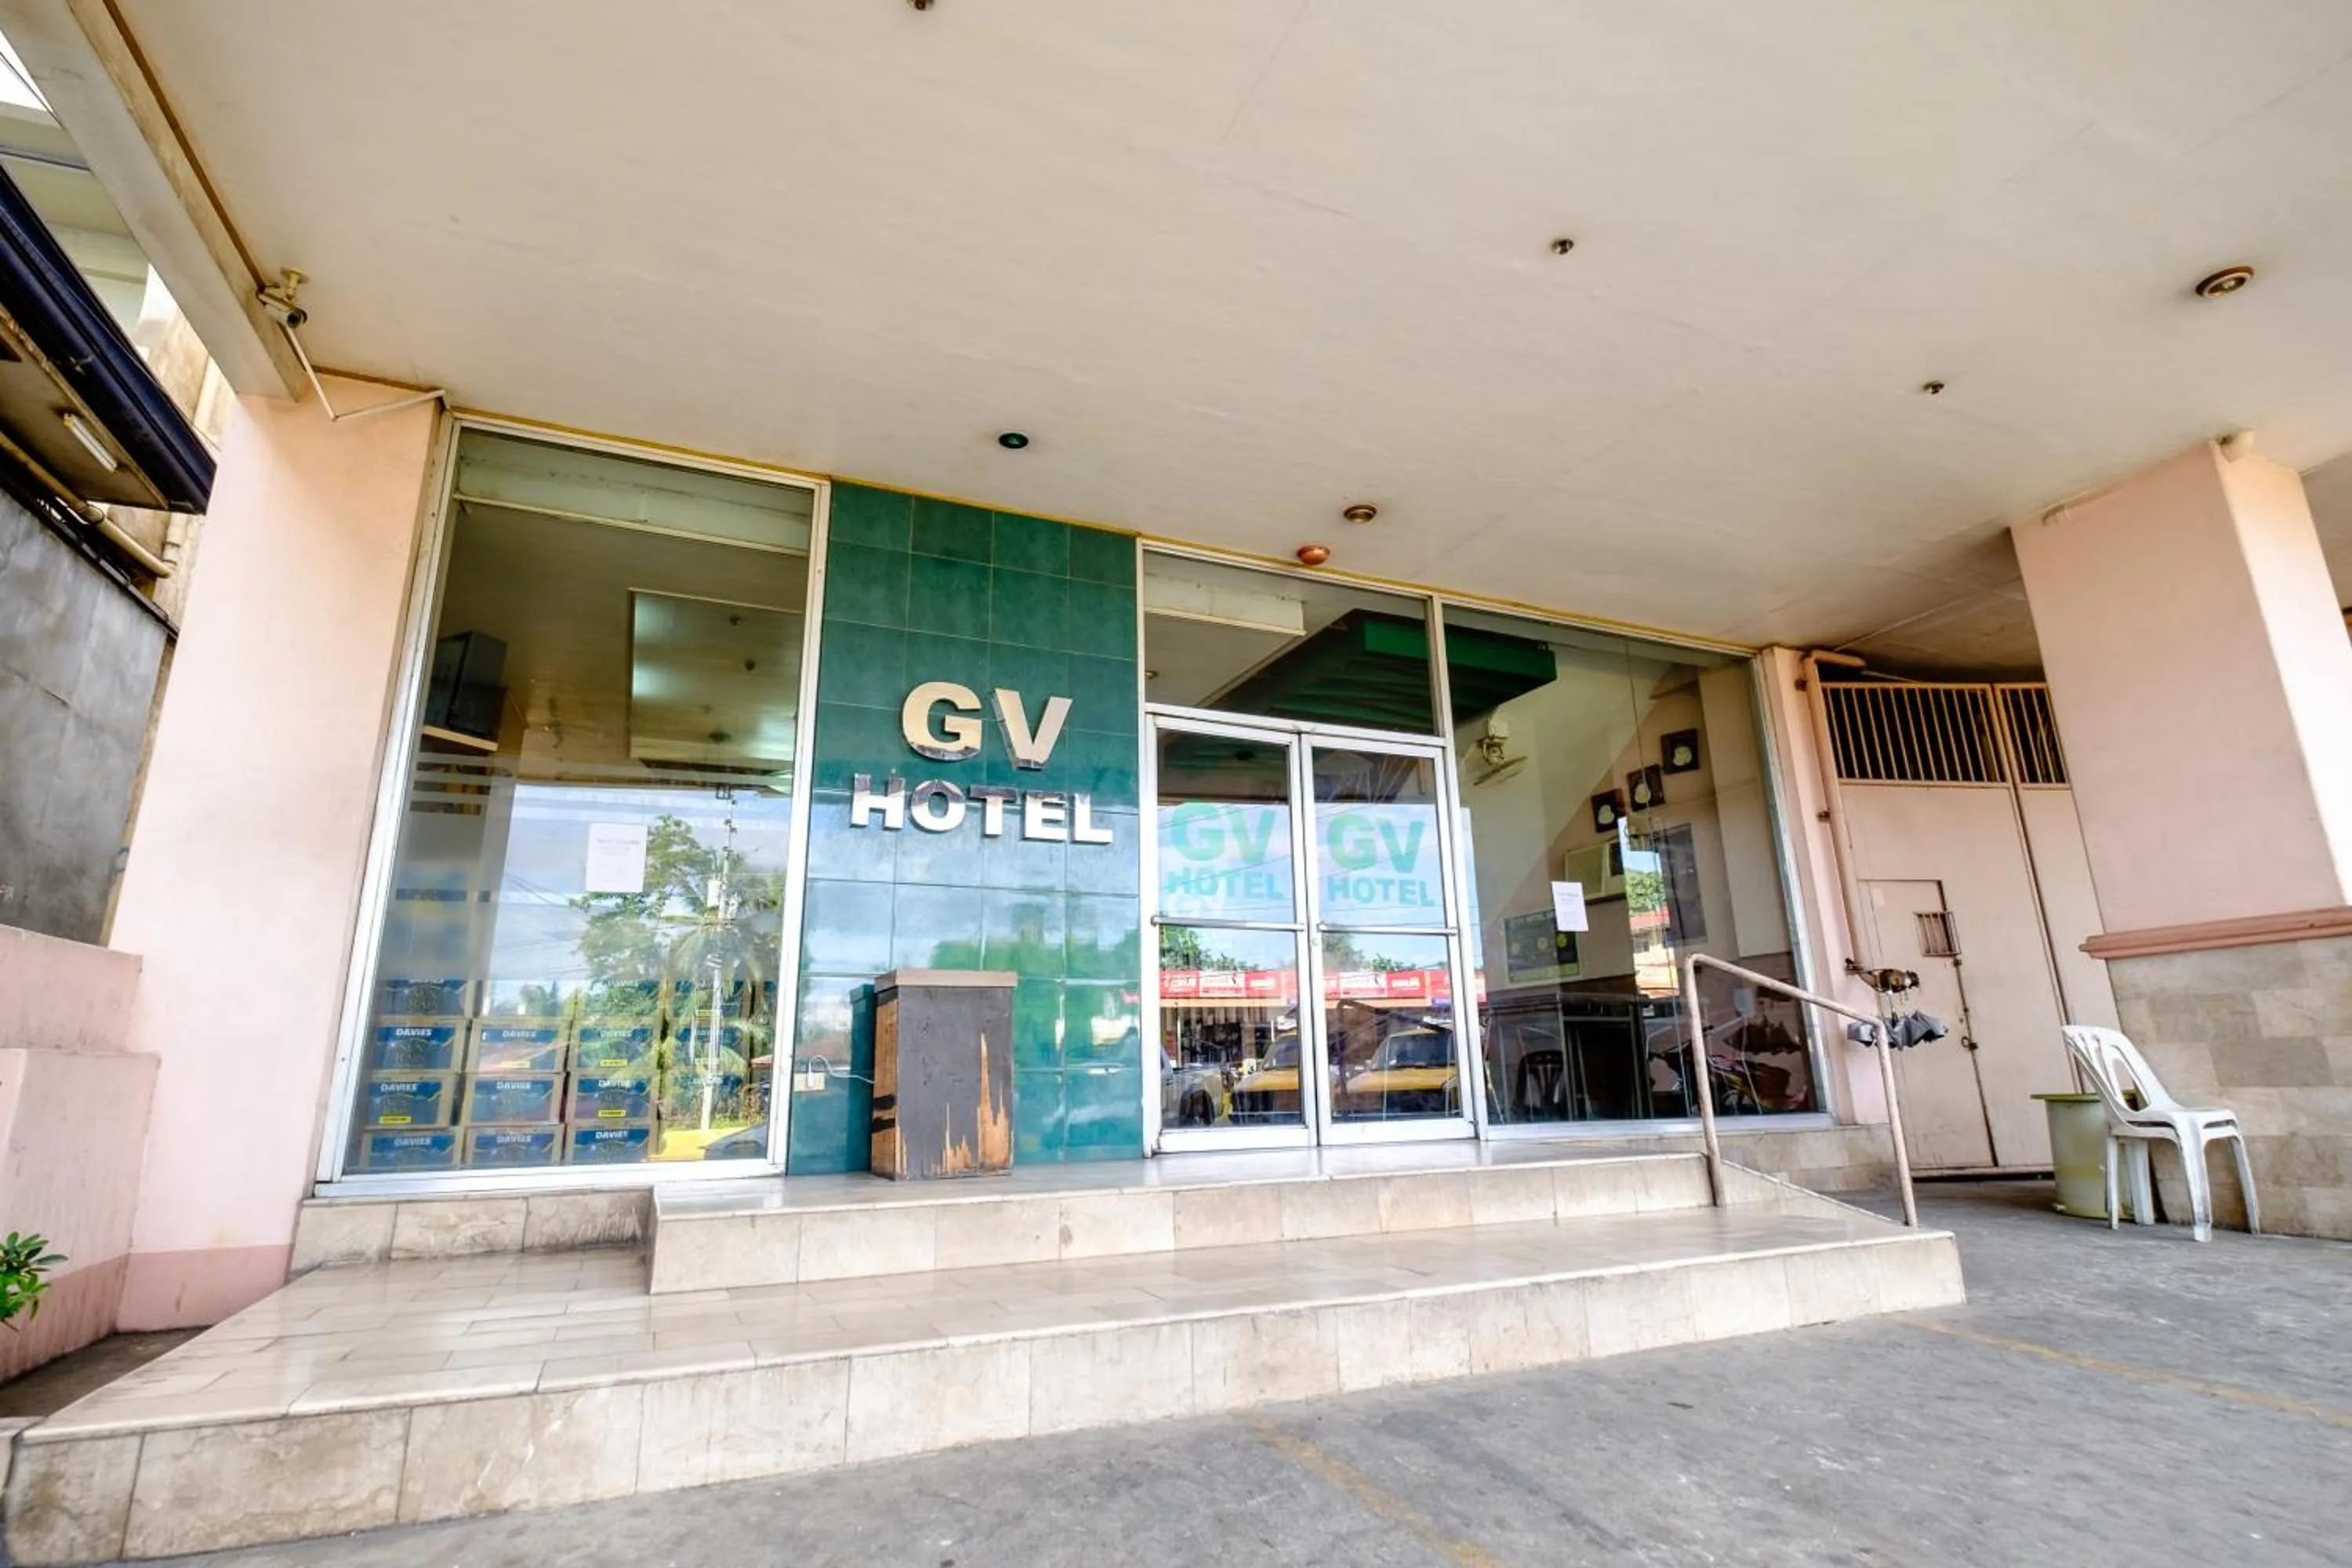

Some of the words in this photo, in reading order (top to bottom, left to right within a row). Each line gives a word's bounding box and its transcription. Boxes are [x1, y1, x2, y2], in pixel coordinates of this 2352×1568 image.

[902, 681, 1073, 771] GV
[850, 772, 1114, 846] HOTEL
[1171, 798, 1278, 863] GV
[1326, 813, 1425, 874] GV
[1164, 866, 1283, 901] HOTEL
[1327, 877, 1436, 907] HOTEL
[395, 1027, 432, 1036] DAVIES
[502, 1029, 538, 1038] DAVIES
[379, 1083, 418, 1092] DAVIES
[495, 1081, 532, 1090] DAVIES
[394, 1138, 432, 1147] DAVIES
[595, 1131, 628, 1139] DAVIES
